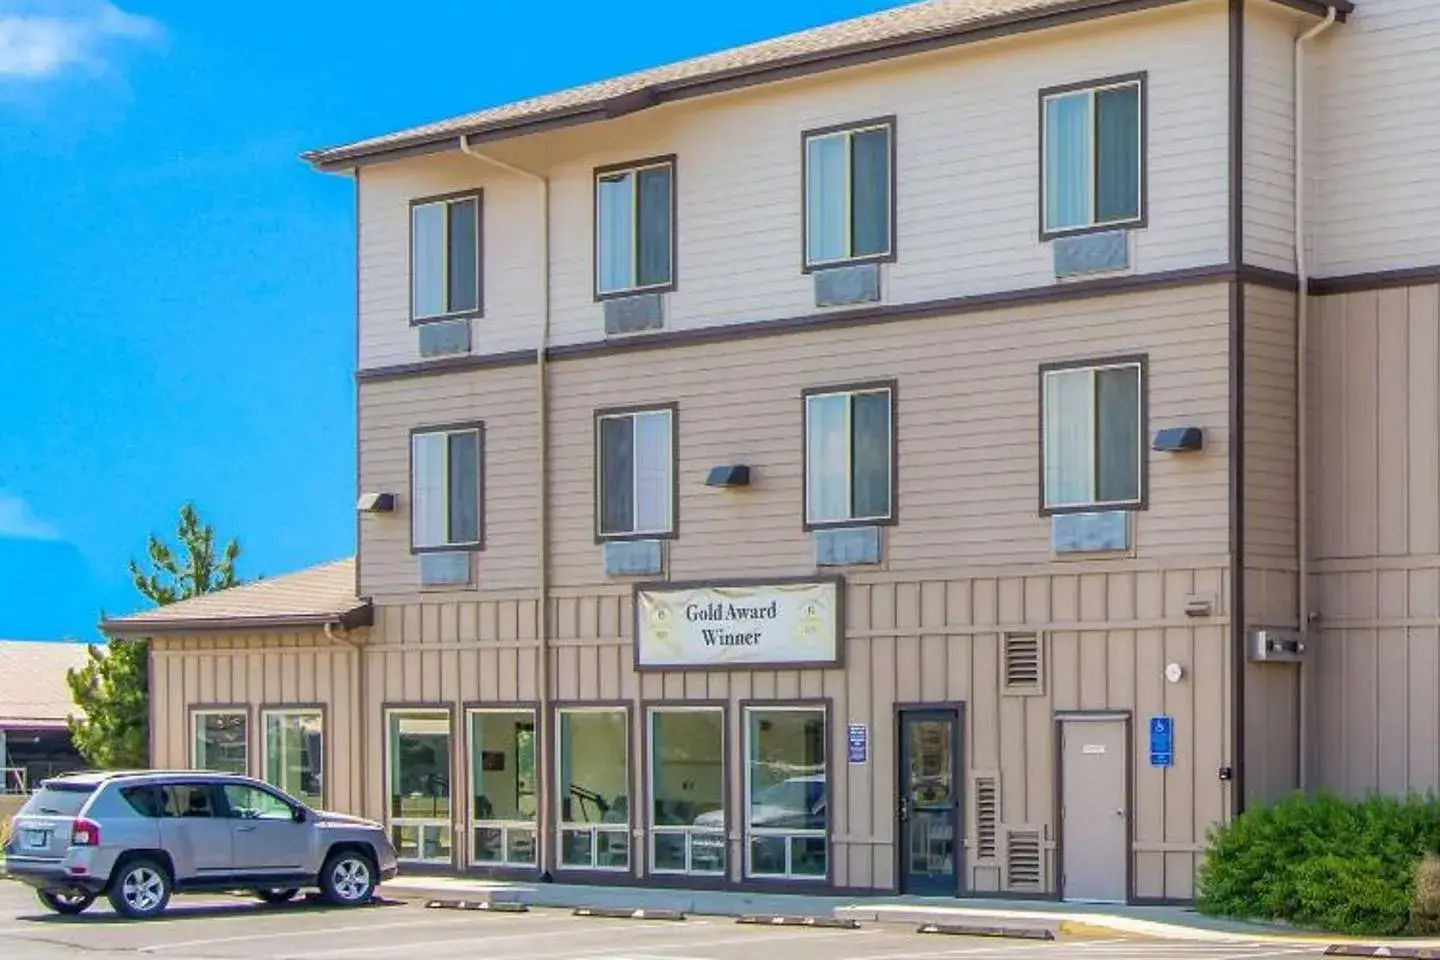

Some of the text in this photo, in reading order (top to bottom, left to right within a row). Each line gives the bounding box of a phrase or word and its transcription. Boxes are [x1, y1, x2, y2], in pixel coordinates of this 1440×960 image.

[686, 603, 723, 622] Gold
[725, 600, 777, 620] Award
[702, 628, 762, 646] Winner
